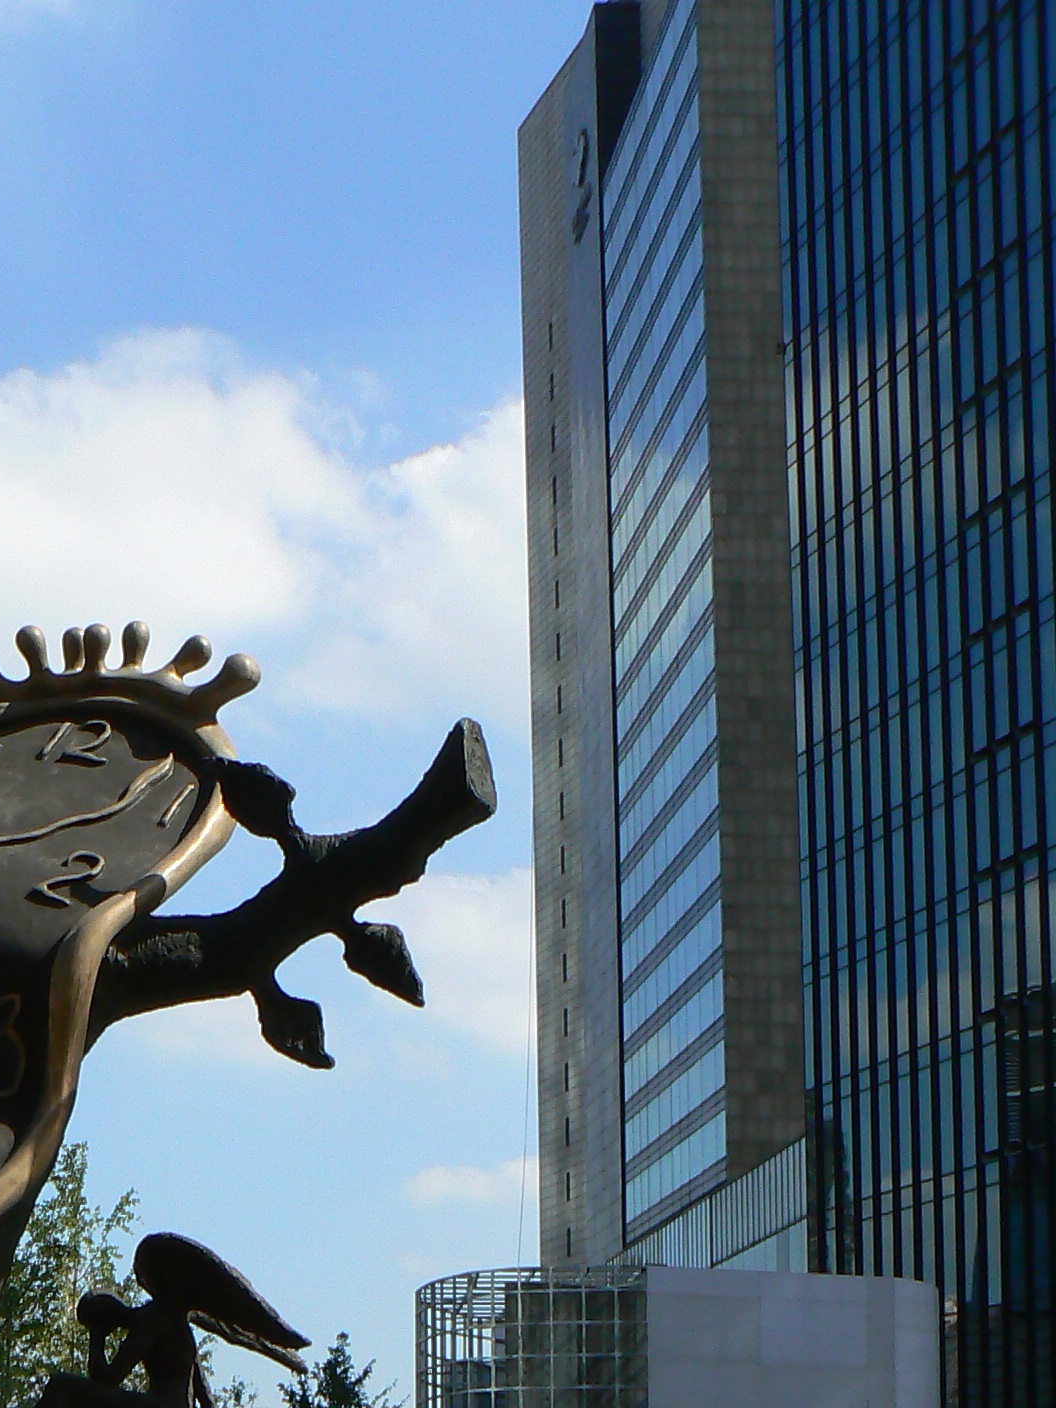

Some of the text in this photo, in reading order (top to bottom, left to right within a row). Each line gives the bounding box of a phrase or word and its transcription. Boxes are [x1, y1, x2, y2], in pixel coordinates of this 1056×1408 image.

[37, 720, 112, 765] 12
[156, 782, 196, 829] 1
[32, 850, 105, 907] 2
